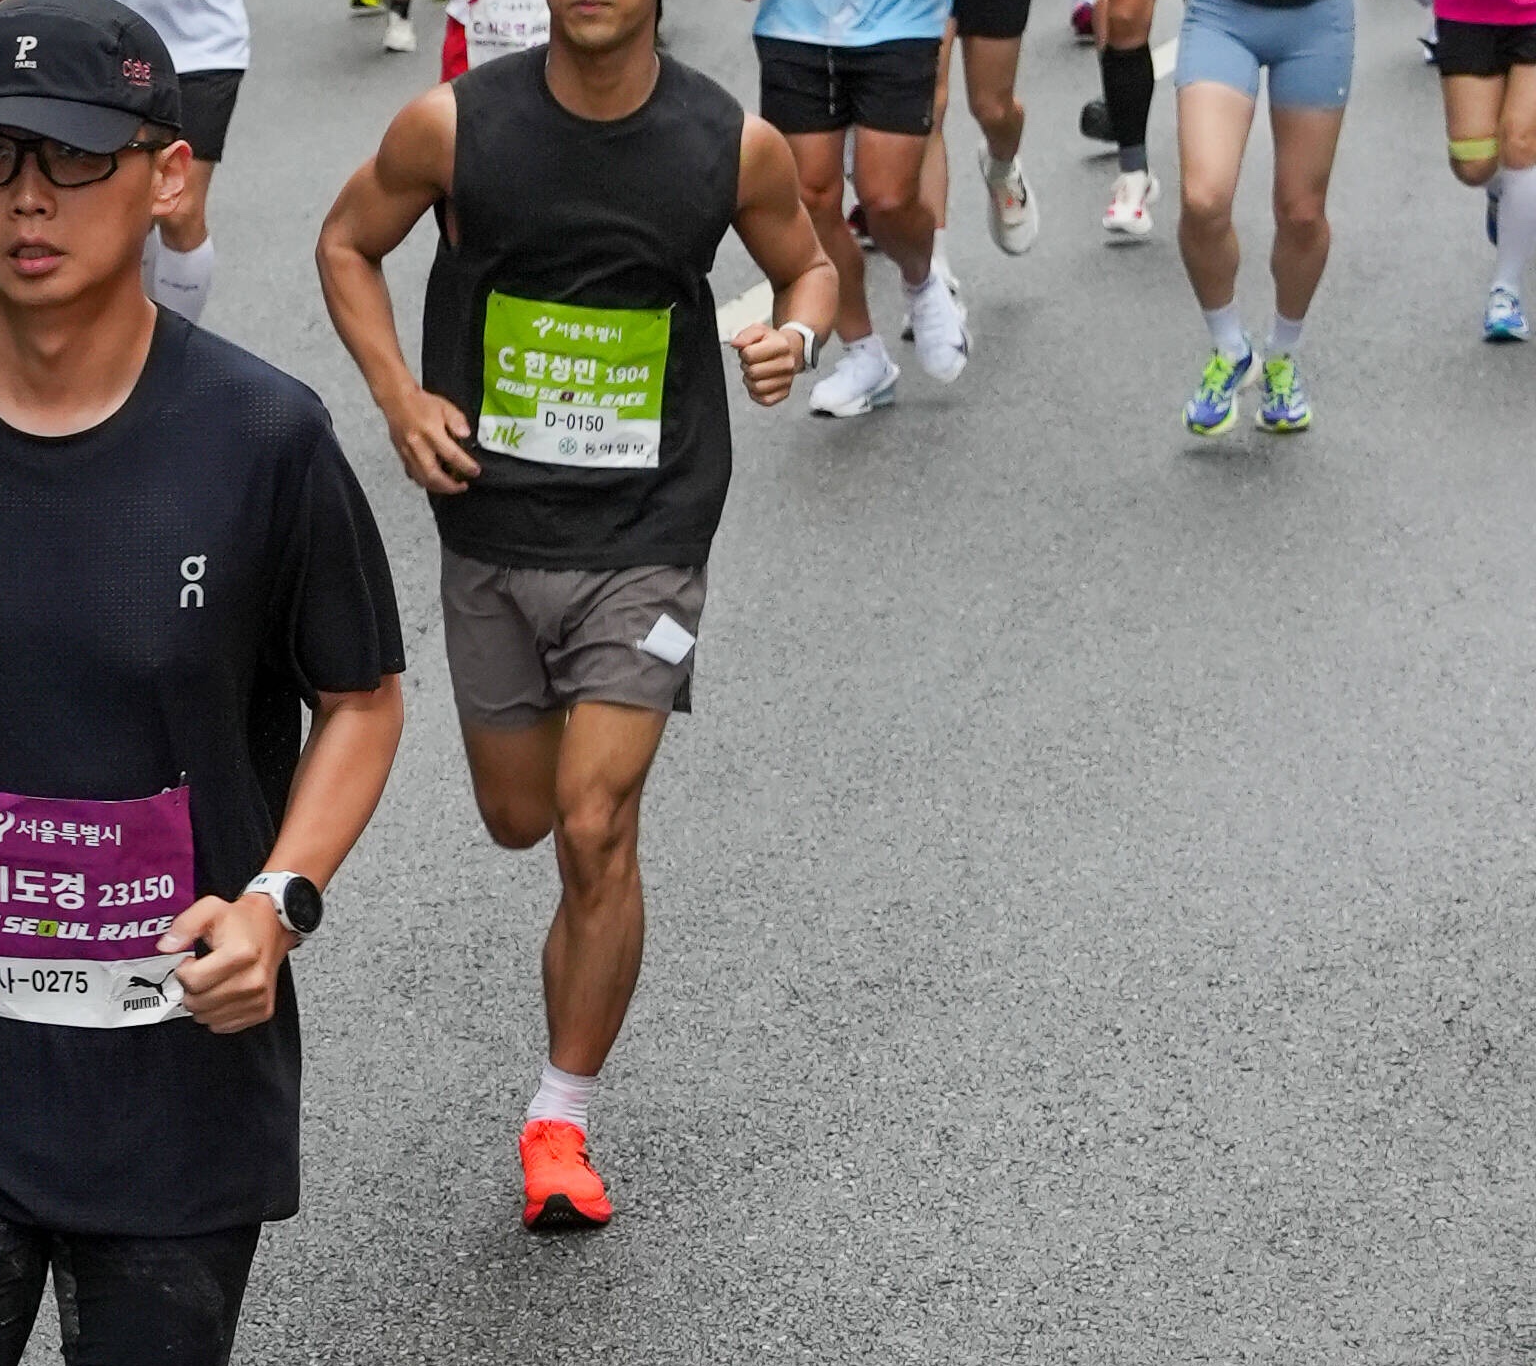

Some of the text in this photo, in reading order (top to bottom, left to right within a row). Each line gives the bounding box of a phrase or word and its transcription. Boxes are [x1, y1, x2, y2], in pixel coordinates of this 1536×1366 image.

[14, 60, 38, 70] PARIS
[555, 322, 623, 344] 서울특별시
[498, 346, 516, 373] C
[605, 365, 650, 385] 1904
[599, 392, 649, 407] RACE
[545, 411, 605, 433] D-0150
[15, 819, 122, 847] 서울특별시
[97, 874, 175, 908] 23150
[1, 915, 98, 942] SEOUL
[96, 915, 176, 942] RACE
[123, 995, 162, 1011] PUMA
